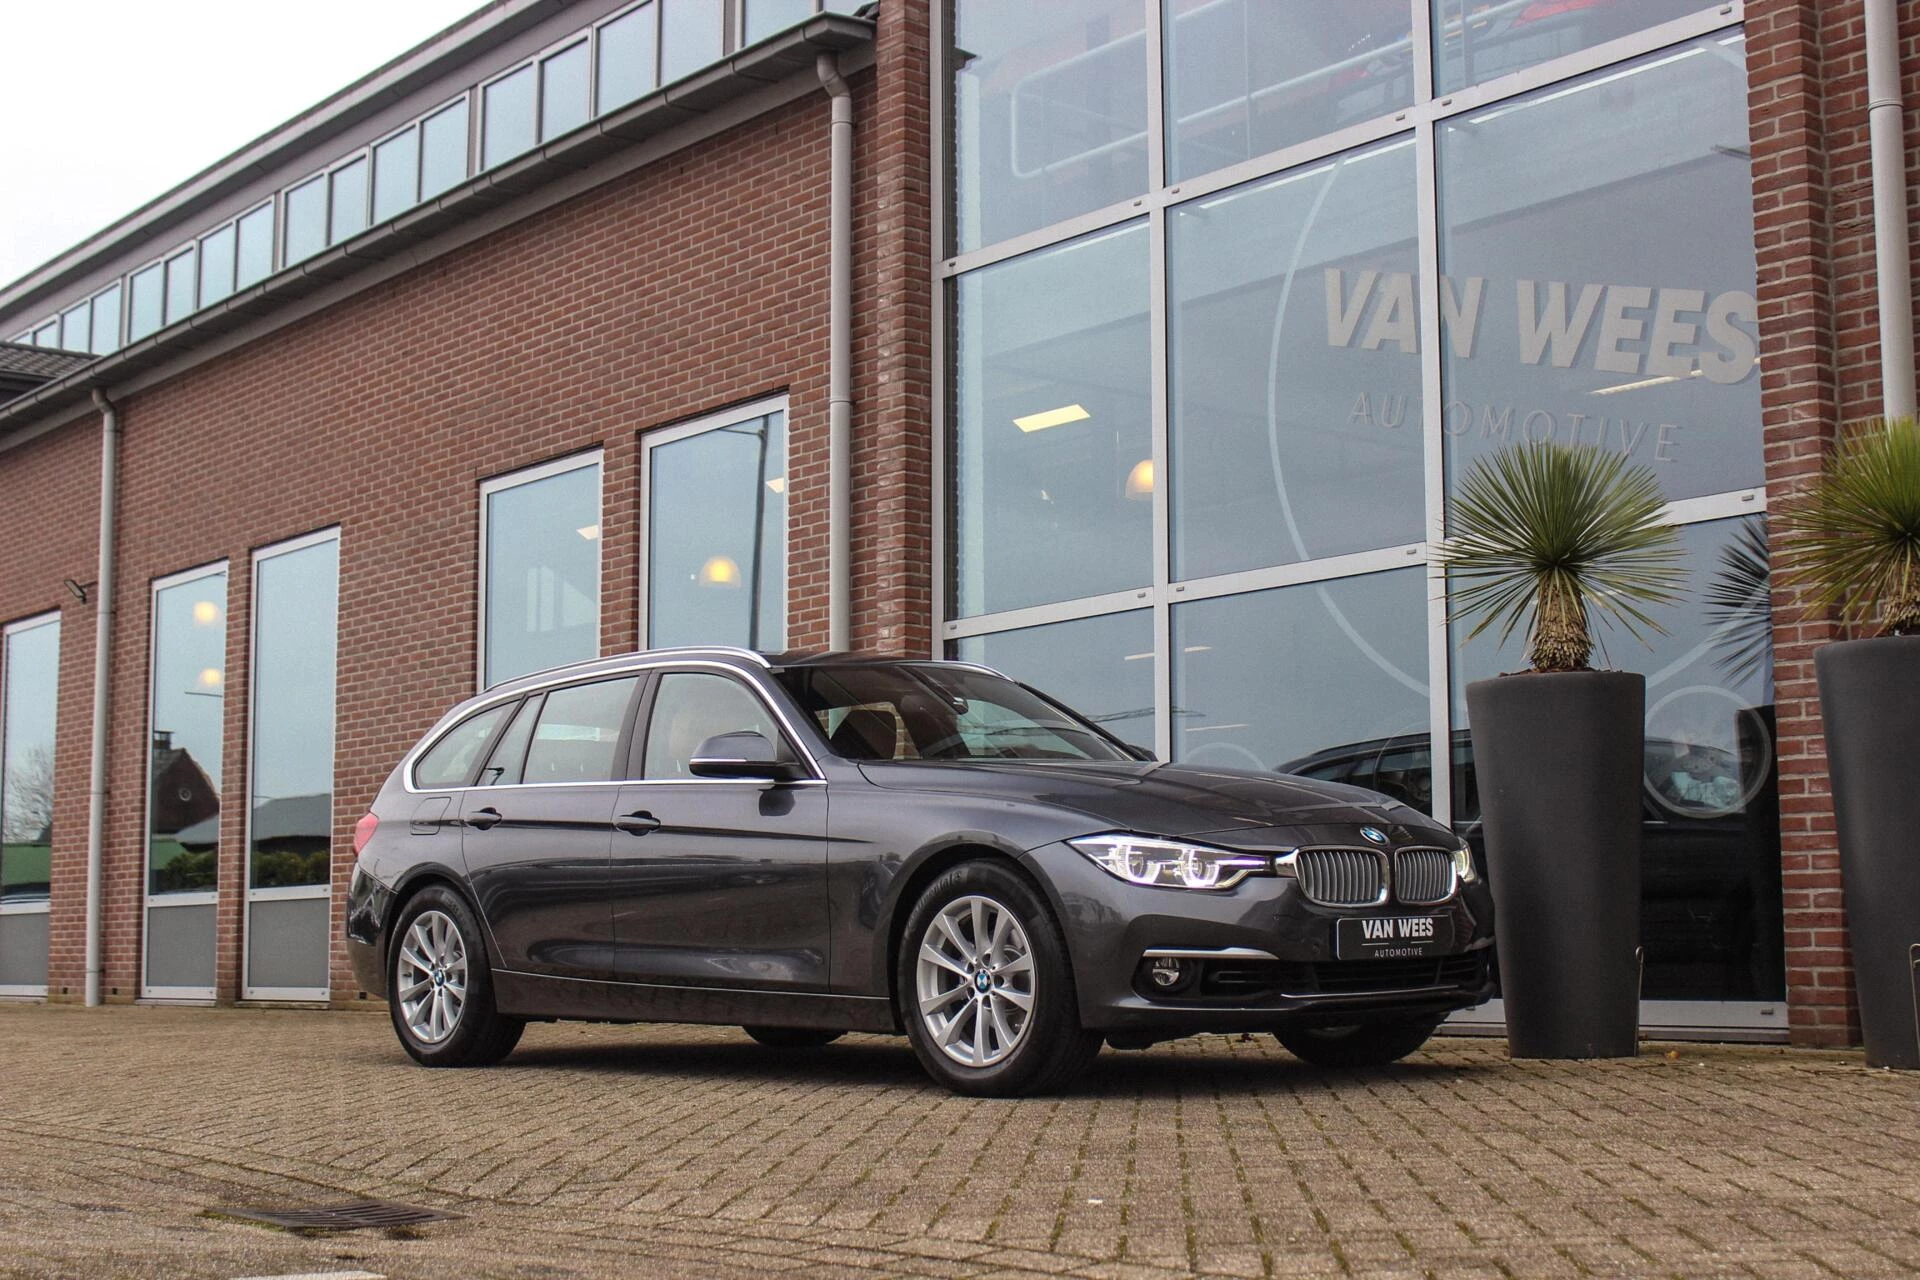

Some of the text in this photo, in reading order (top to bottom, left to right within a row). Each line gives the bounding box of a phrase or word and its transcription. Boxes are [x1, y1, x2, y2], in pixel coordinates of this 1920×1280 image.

[1325, 268, 1758, 384] VAN WEES
[1350, 391, 1683, 463] AUOMOTIVE
[1362, 917, 1434, 939] VAN WEES
[1374, 947, 1423, 958] AUTOMOTIVE
